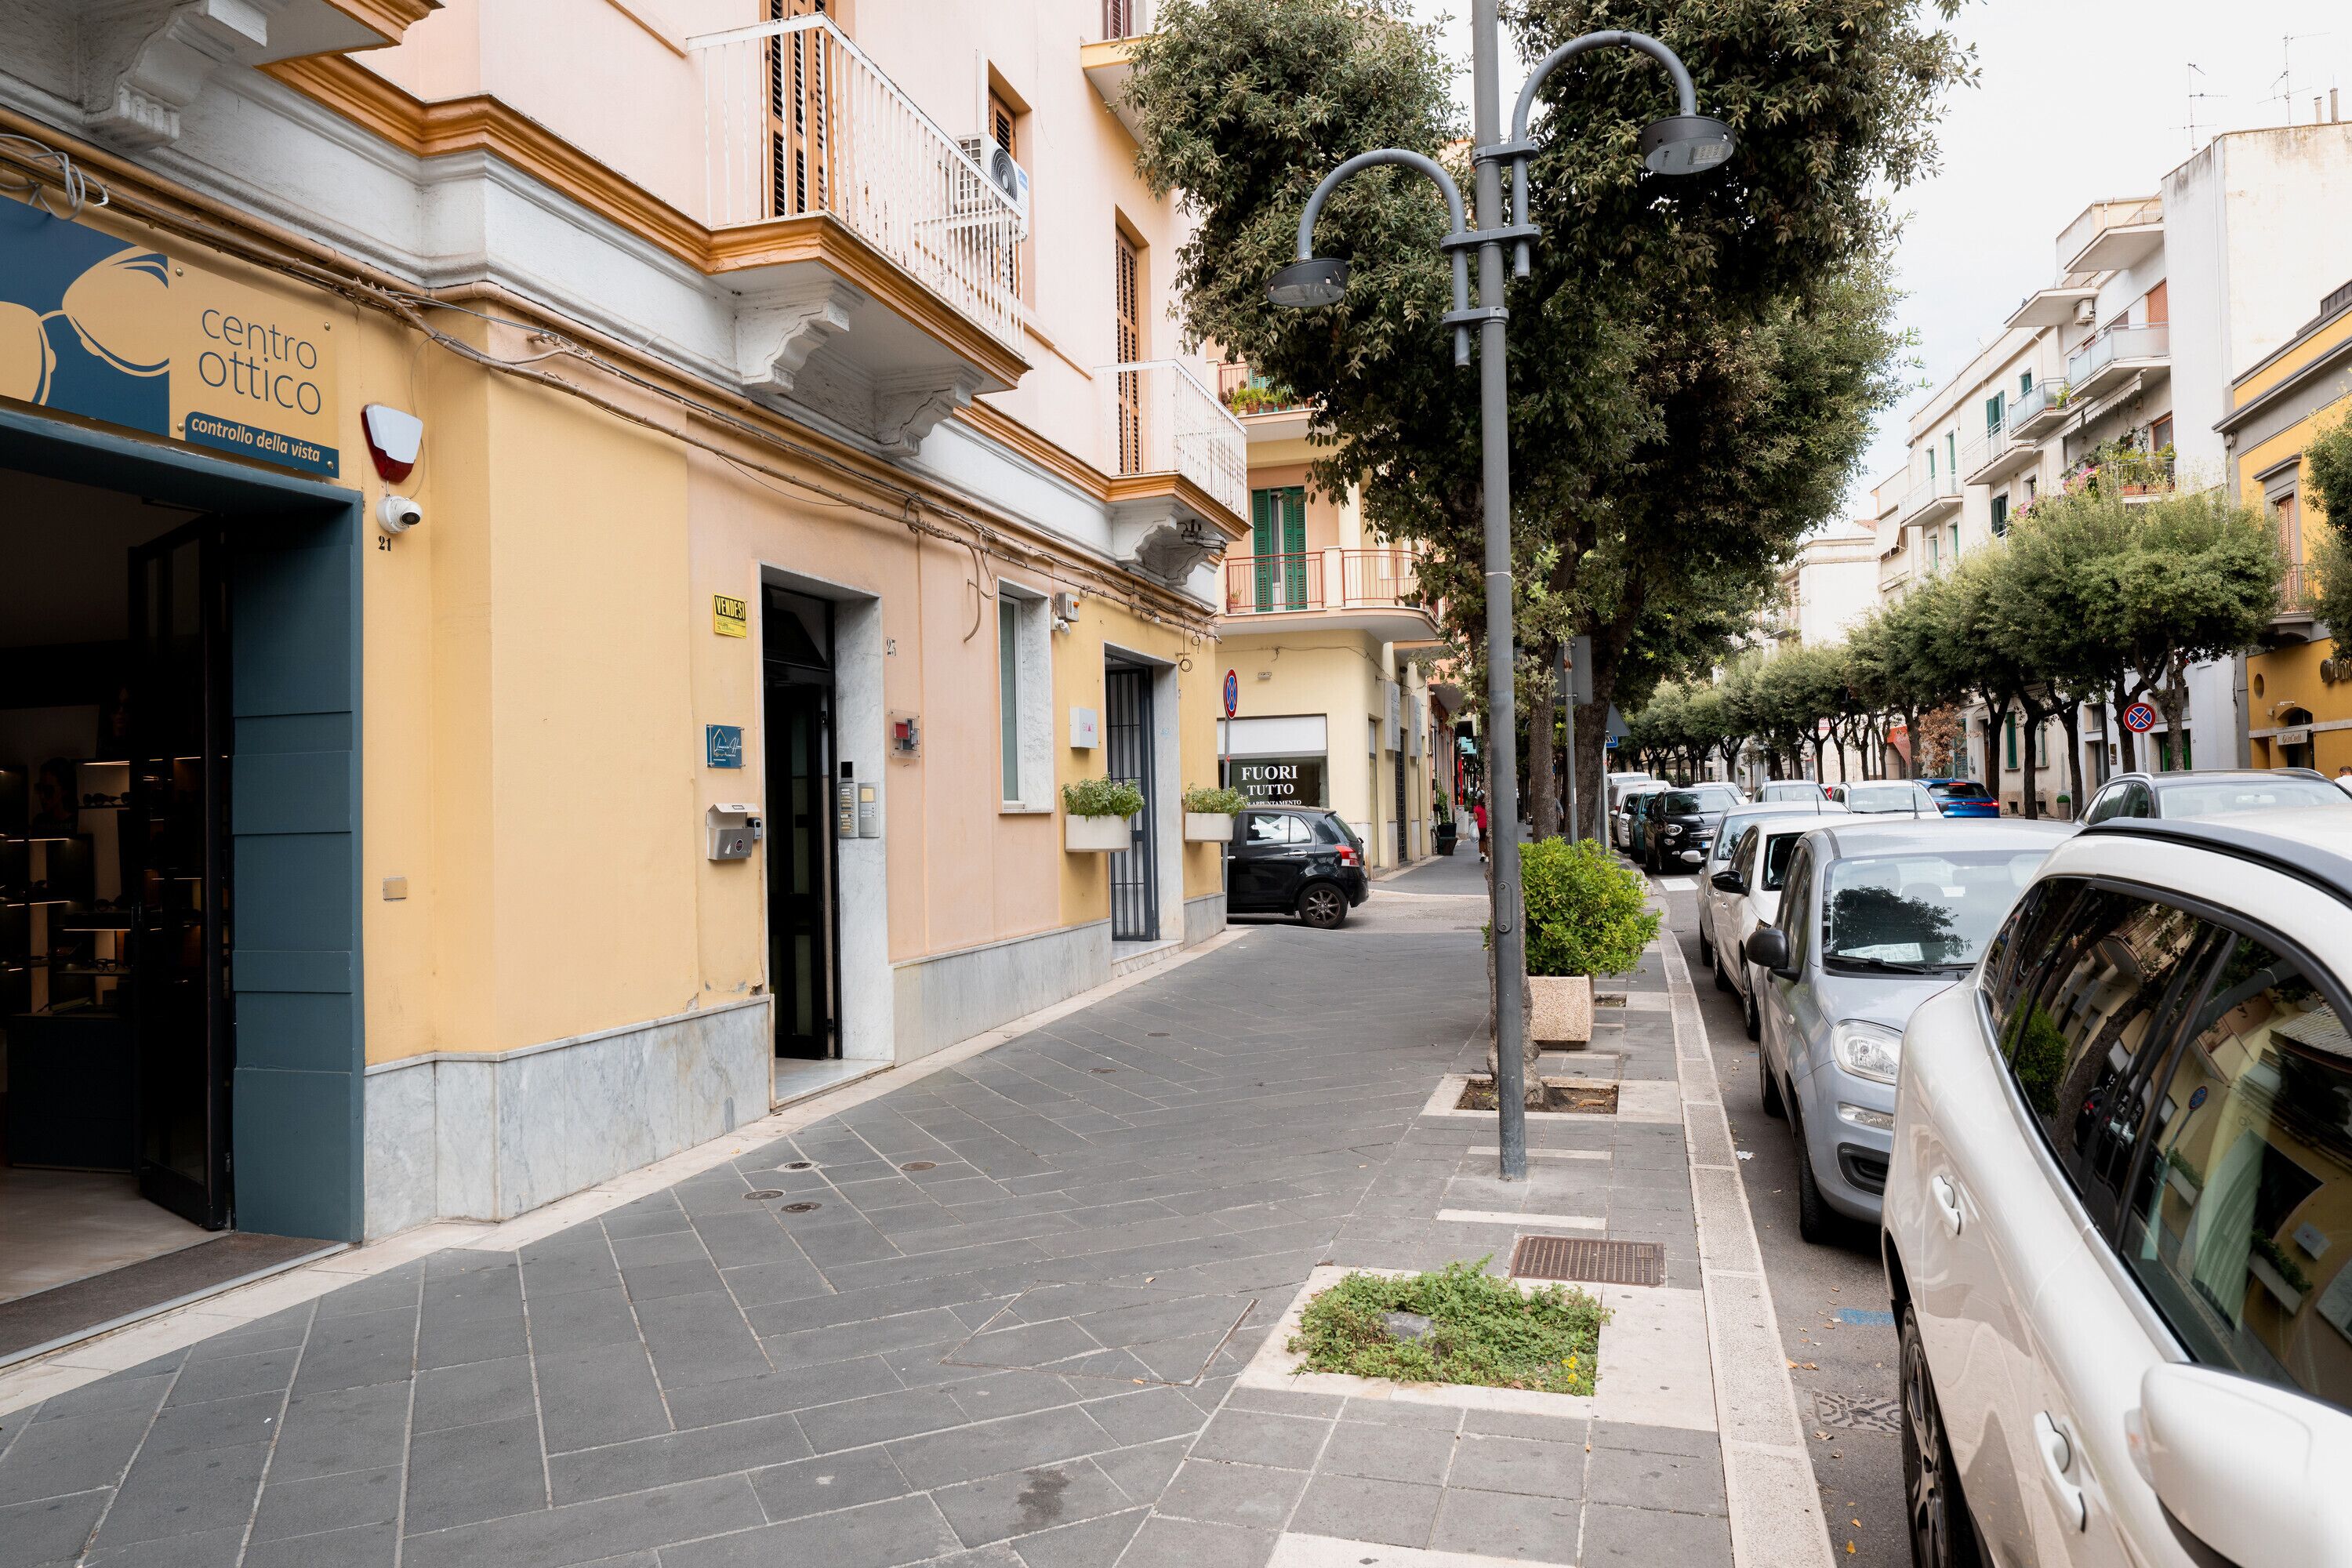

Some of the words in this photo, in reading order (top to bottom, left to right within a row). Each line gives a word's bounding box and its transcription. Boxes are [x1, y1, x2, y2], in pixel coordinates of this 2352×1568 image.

[201, 309, 317, 370] centro
[191, 418, 253, 445] controllo
[256, 431, 289, 454] della
[291, 441, 321, 463] vista
[379, 535, 391, 552] 21
[714, 595, 746, 620] VENDESI
[1241, 764, 1298, 781] FUORI
[1247, 783, 1294, 796] TUTTO
